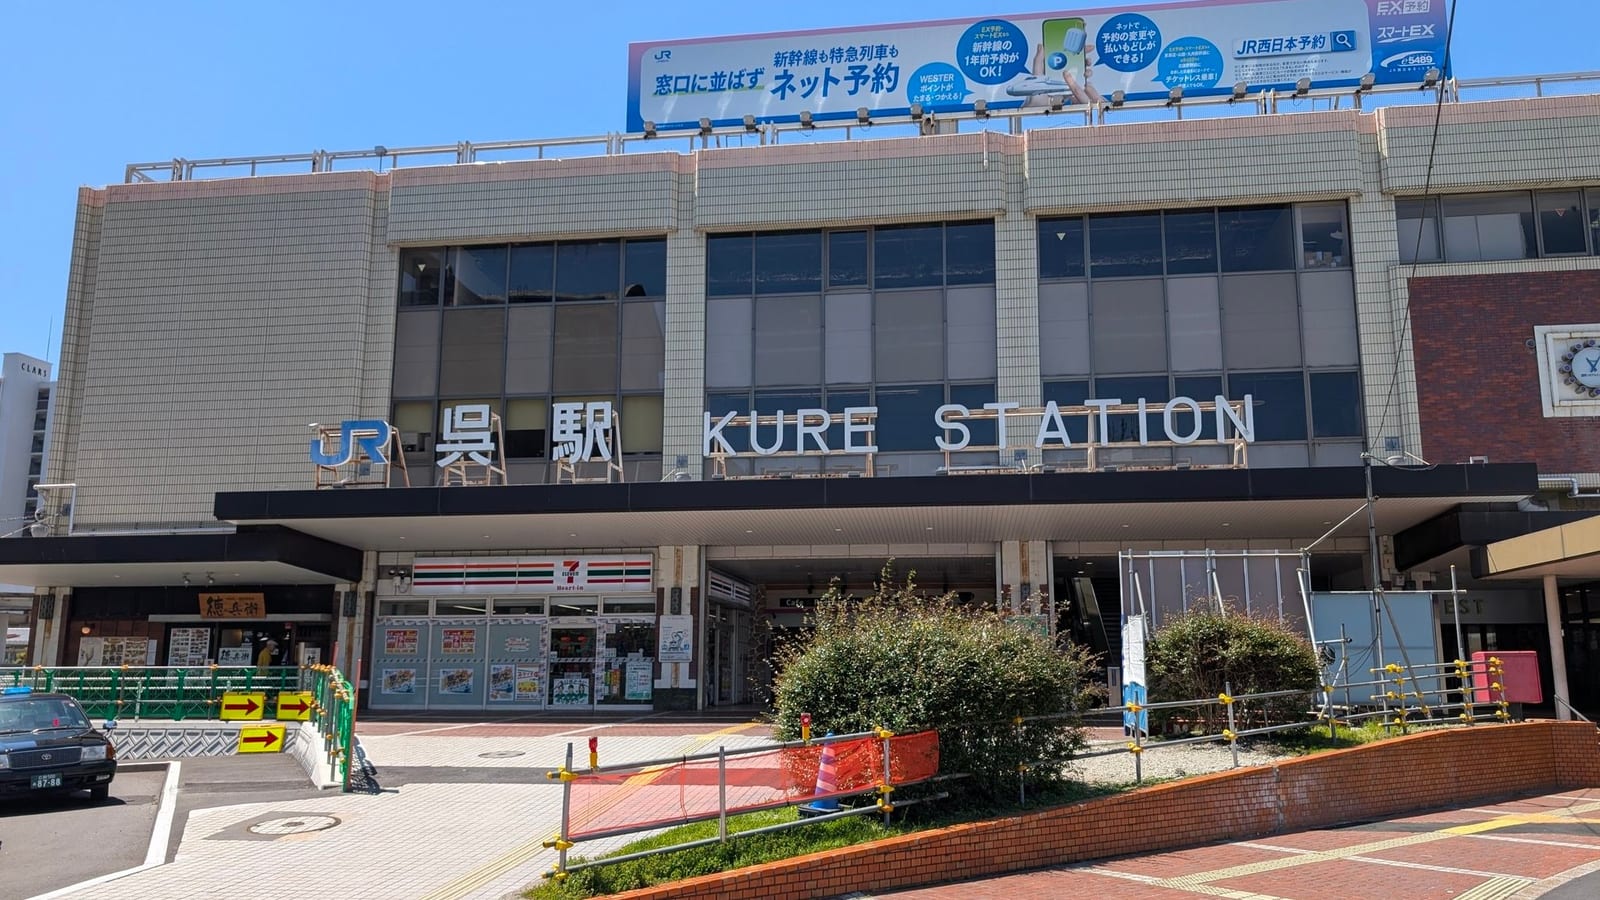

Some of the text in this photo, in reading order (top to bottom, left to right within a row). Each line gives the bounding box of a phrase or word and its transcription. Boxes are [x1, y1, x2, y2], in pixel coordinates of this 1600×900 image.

[1116, 22, 1140, 31] ネットで
[1377, 24, 1436, 39] スマートEX
[1101, 30, 1157, 44] 予約の変更や
[972, 40, 1012, 53] 新幹線の
[1104, 42, 1156, 54] 払いもどしが
[1237, 35, 1326, 55] JR西日本予約
[654, 50, 672, 60] JR
[773, 43, 899, 68] 新幹線も特急列車も
[964, 52, 1020, 66] 1年前予約が
[920, 73, 955, 84] WESTER
[979, 65, 1002, 78] OK!
[653, 67, 765, 96] 窓口に並ばず
[770, 62, 900, 101] ネット予約
[920, 84, 954, 93] ポイントが
[311, 394, 1256, 468] JR 呉駅 KURE STATION
